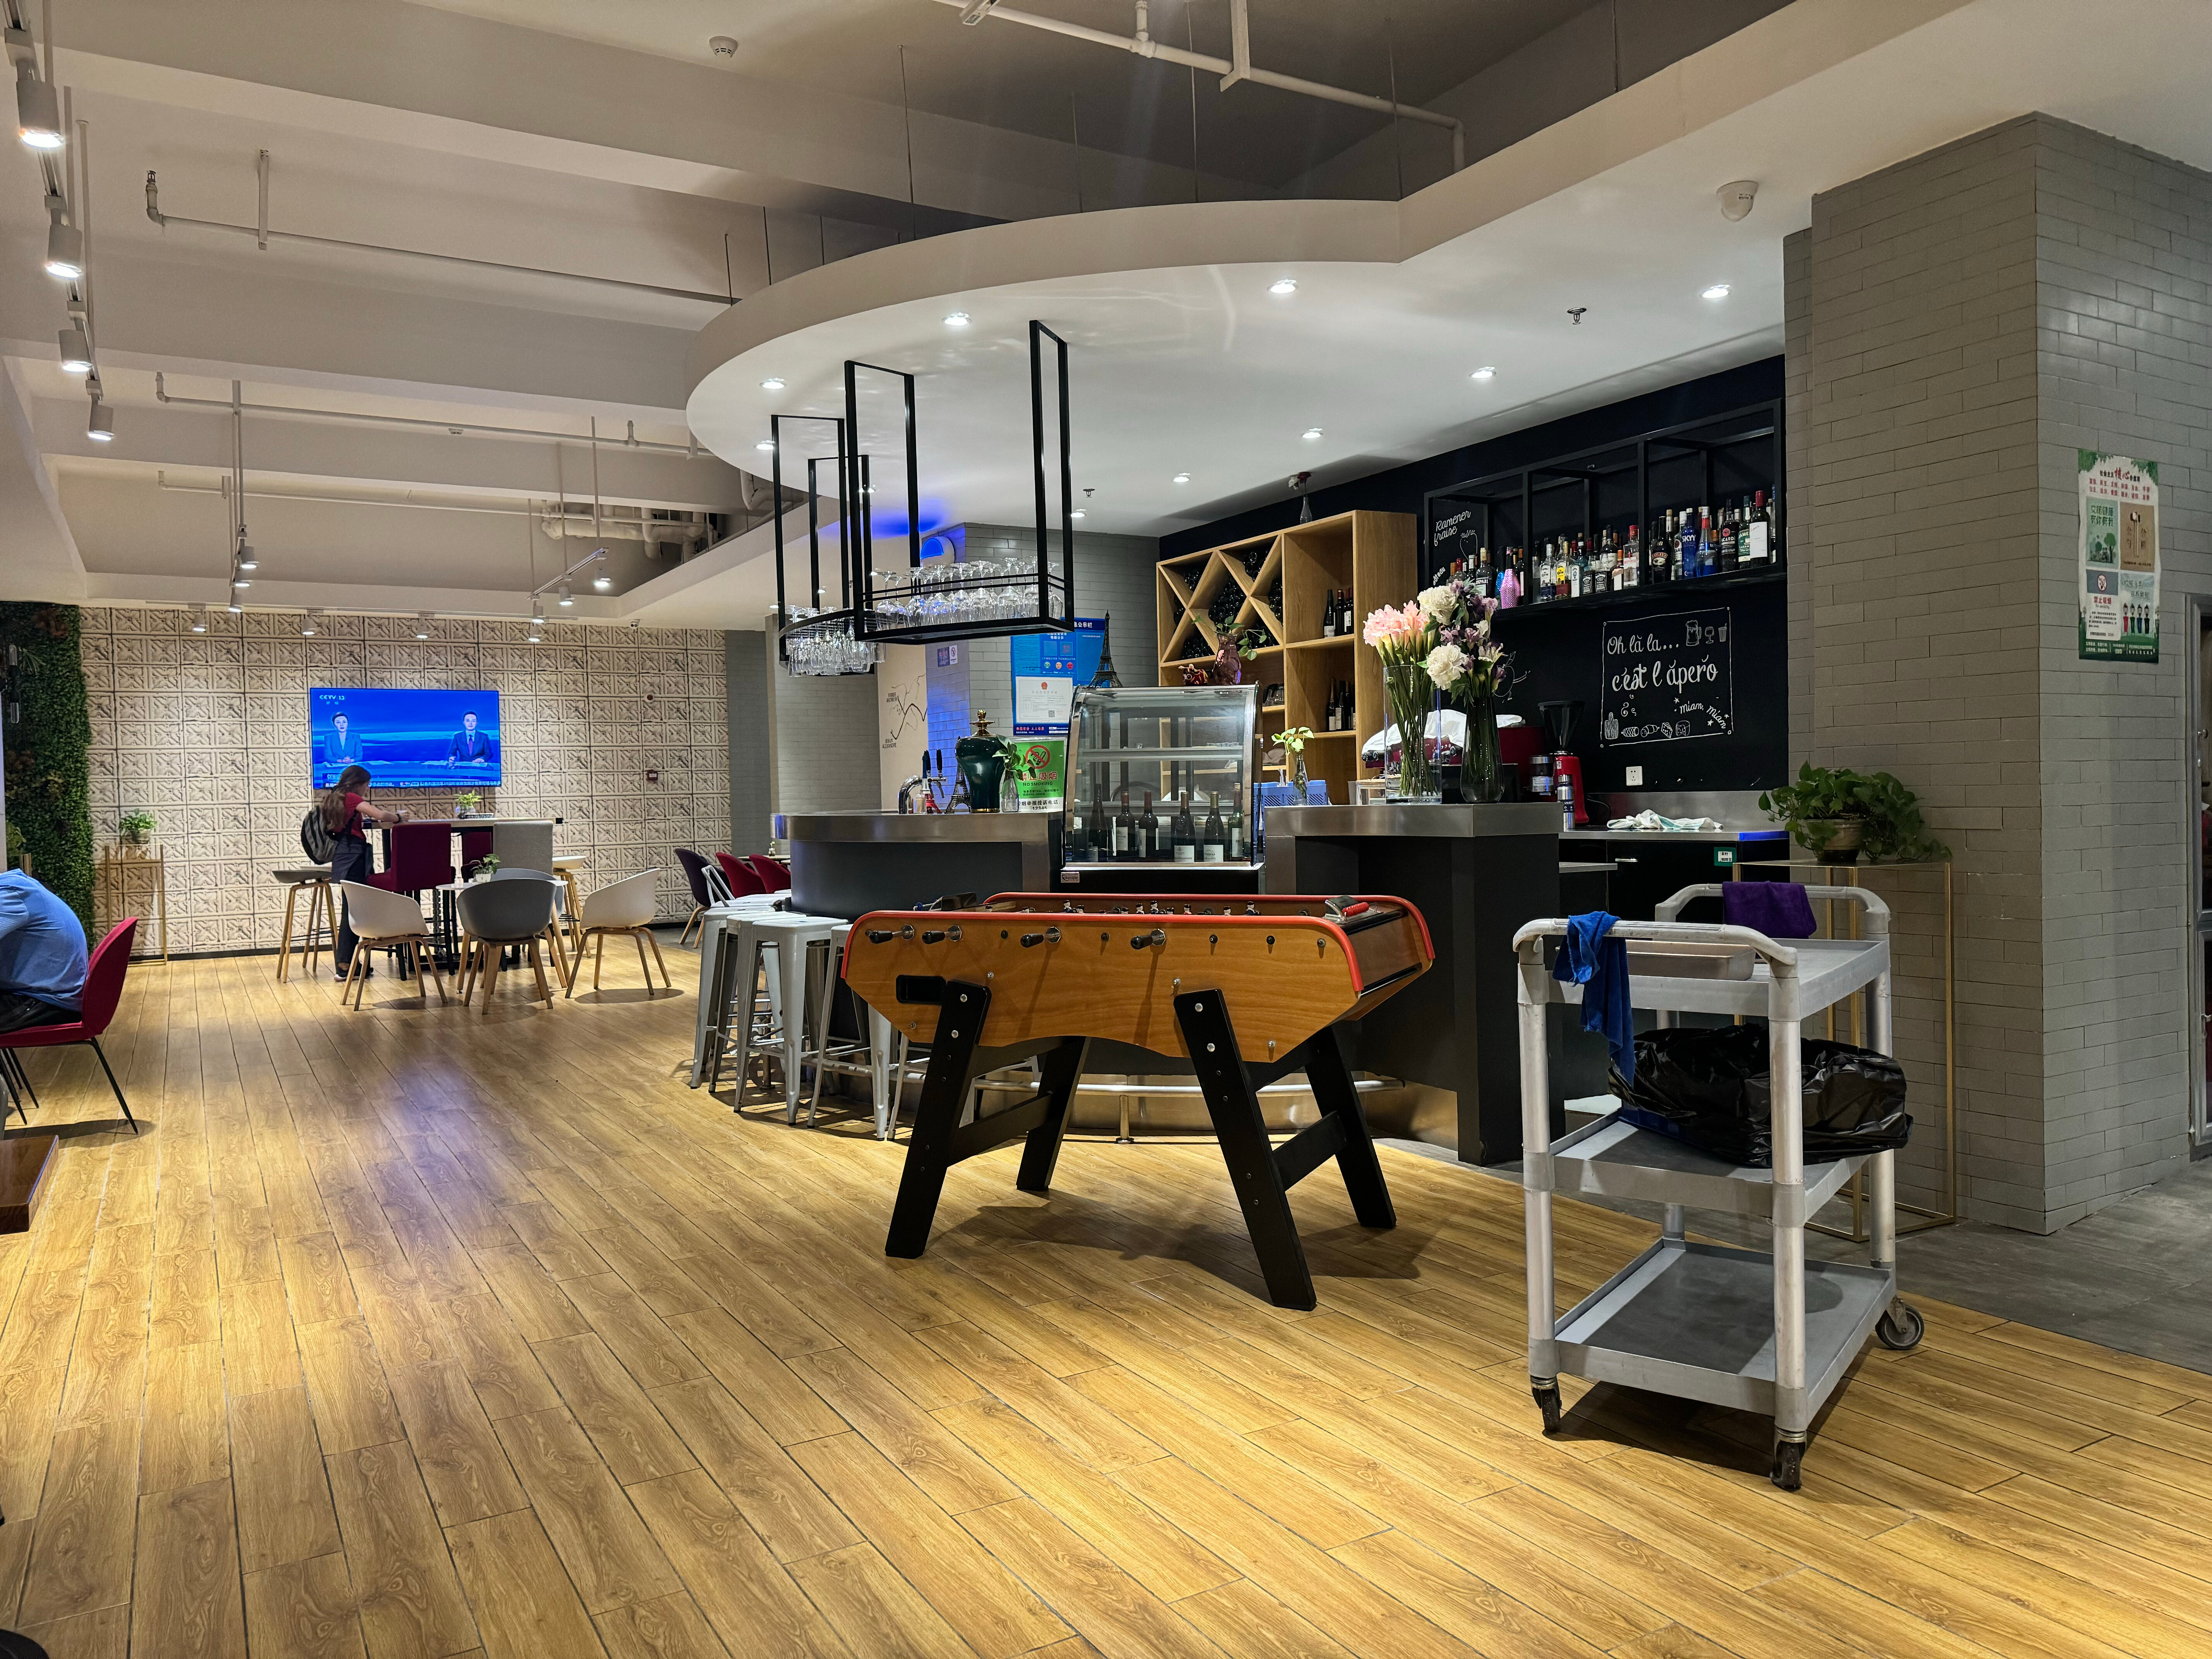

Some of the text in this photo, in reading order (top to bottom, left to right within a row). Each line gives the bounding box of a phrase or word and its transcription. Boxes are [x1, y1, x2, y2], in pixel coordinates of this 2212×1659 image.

[1436, 510, 1471, 532] Ramener
[1434, 526, 1457, 546] fraise
[1607, 636, 1626, 654] Oh
